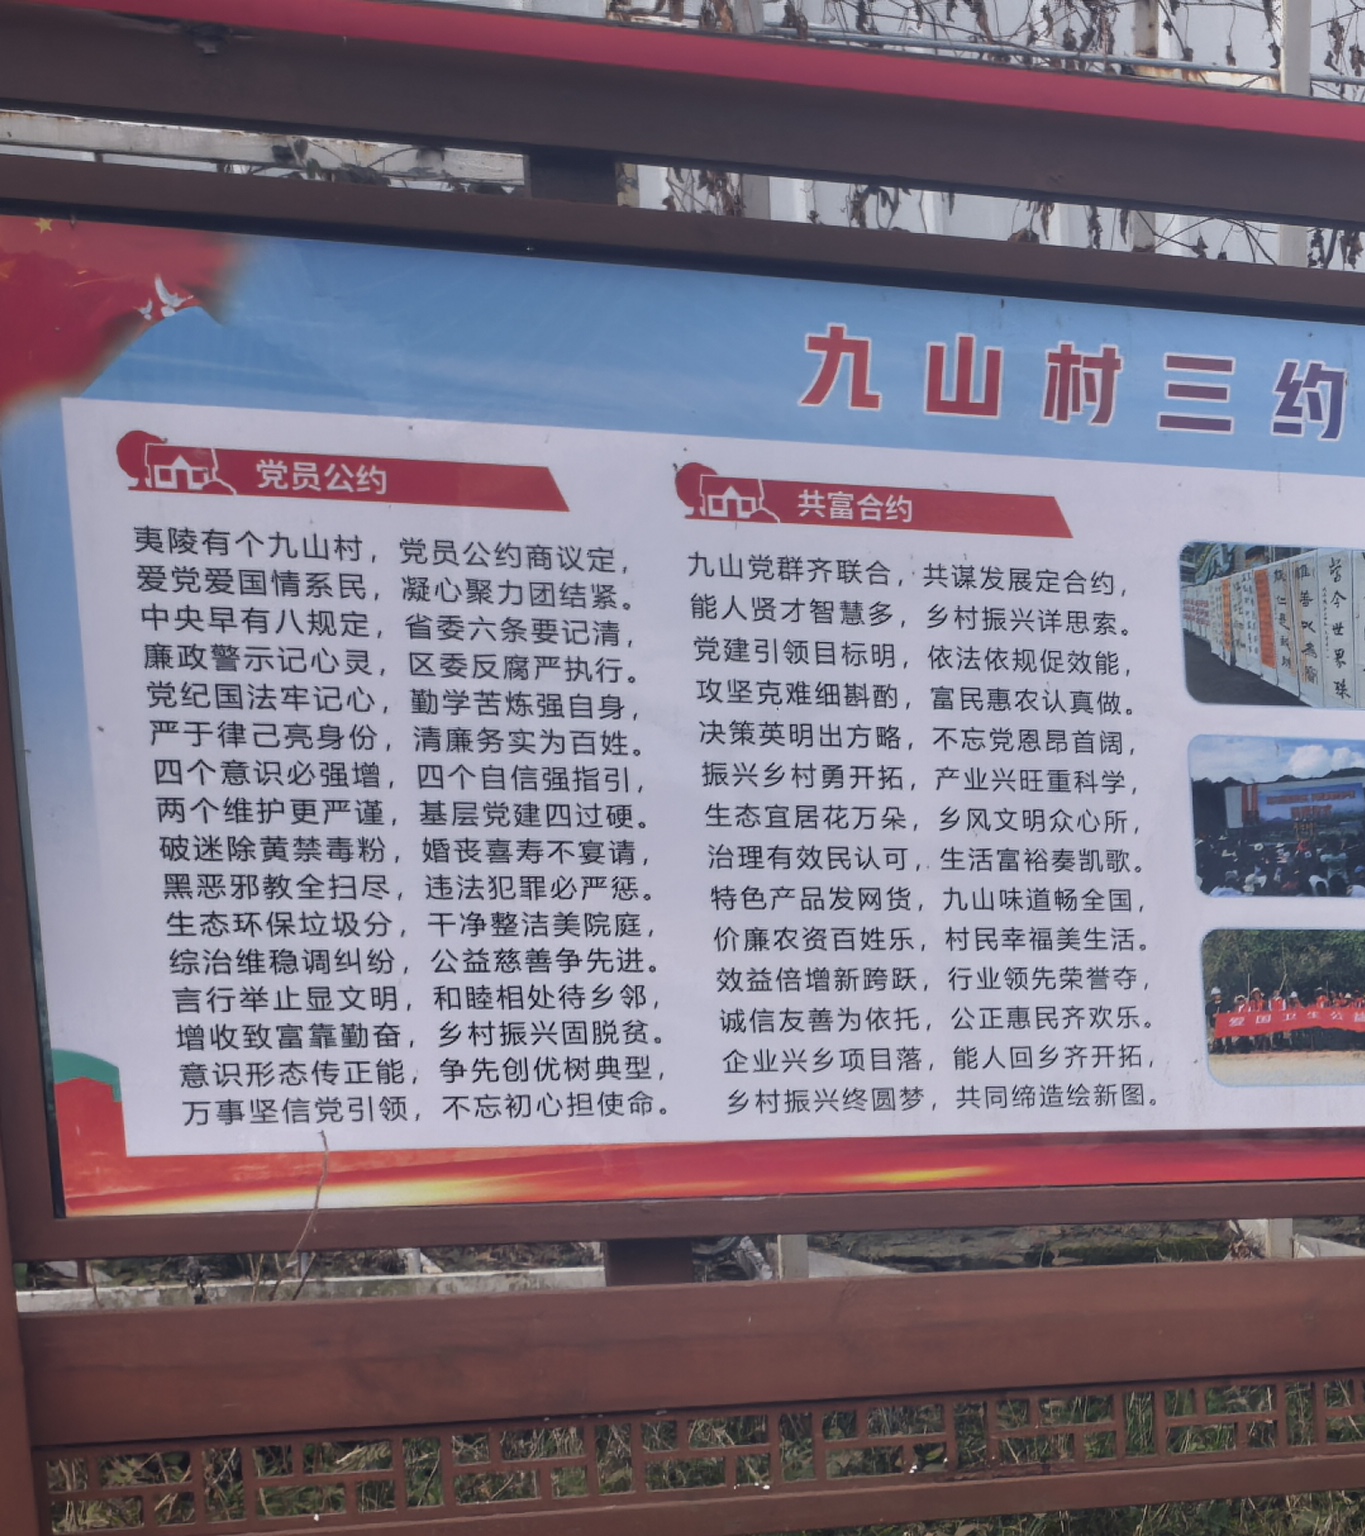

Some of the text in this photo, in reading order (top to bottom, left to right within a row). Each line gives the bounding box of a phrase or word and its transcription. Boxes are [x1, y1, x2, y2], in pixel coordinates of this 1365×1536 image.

[799, 324, 1348, 441] 九山村三约
[256, 458, 388, 496] 党员公约
[797, 489, 913, 524] 共富合约
[134, 526, 628, 575] 夷陵有个九山村，党员公约商议定，
[137, 566, 632, 611] 爱党爱国情系民，凝心聚力团结紧。
[688, 551, 1126, 598] 九山党群齐联合，共谋发展定合约，
[141, 603, 633, 647] 中央早有八规定，省委六条要记清，
[690, 593, 1130, 637] 能人贤才智慧多，乡村振兴详思索。
[144, 643, 636, 684] 廉政警示记心灵，区委反腐严执行。
[693, 636, 1131, 677] 党建引领目标明，依法依规促效能，
[147, 681, 638, 721] 党纪国法牢记心，勤学苦炼强自身，
[696, 679, 1134, 717] 攻坚克难细斟酌，富民惠农认真做。
[150, 721, 642, 757] 严于律己亮身份，清廉务实为百姓。
[699, 720, 1136, 756] 决策英明出方略，不忘党恩昂首阔，
[153, 759, 643, 795] 四个意识必强增，四个自信强指引，
[701, 761, 1138, 795] 振兴乡村勇开拓，产业兴旺重科学，
[157, 797, 647, 830] 两个维护更严谨，基层党建四过硬。
[704, 803, 1141, 836] 生态宜居花万朵，乡风文明众心所，
[159, 837, 649, 866] 破迷除黄禁毒粉，婚丧喜寿不宴请，
[708, 844, 1144, 874] 治理有效民认可，生活富裕奏凯歌。
[163, 874, 653, 902] 黑恶邪教全扫尽，违法犯罪必严惩。
[710, 886, 1145, 914] 特色产品发网货，九山味道畅全国，
[166, 911, 656, 938] 生态环保垃圾分，干净整洁美院庭，
[713, 925, 1149, 953] 价廉农资百姓乐，村民幸福美生活。
[169, 948, 658, 976] 综治维稳调纠纷，公益慈善争先进。
[717, 966, 1150, 994] 效益倍增新跨跃，行业领先荣誉夺，
[172, 984, 660, 1014] 言行举止显文明，和睦相处待乡邻，
[176, 1021, 664, 1051] 增收致富靠勤奋，乡村振兴固脱贫。
[719, 1004, 1153, 1034] 诚信友善为依托，公正惠民齐欢乐。
[179, 1055, 665, 1089] 意识形态传正能，争先创优树典型，
[723, 1044, 1155, 1074] 企业兴乡项目落，能人回乡齐开拓，
[182, 1091, 669, 1127] 万事坚信党引领，不忘初心担使命。
[727, 1083, 1158, 1115] 乡村振兴终圆梦，共同缔造绘新图。
